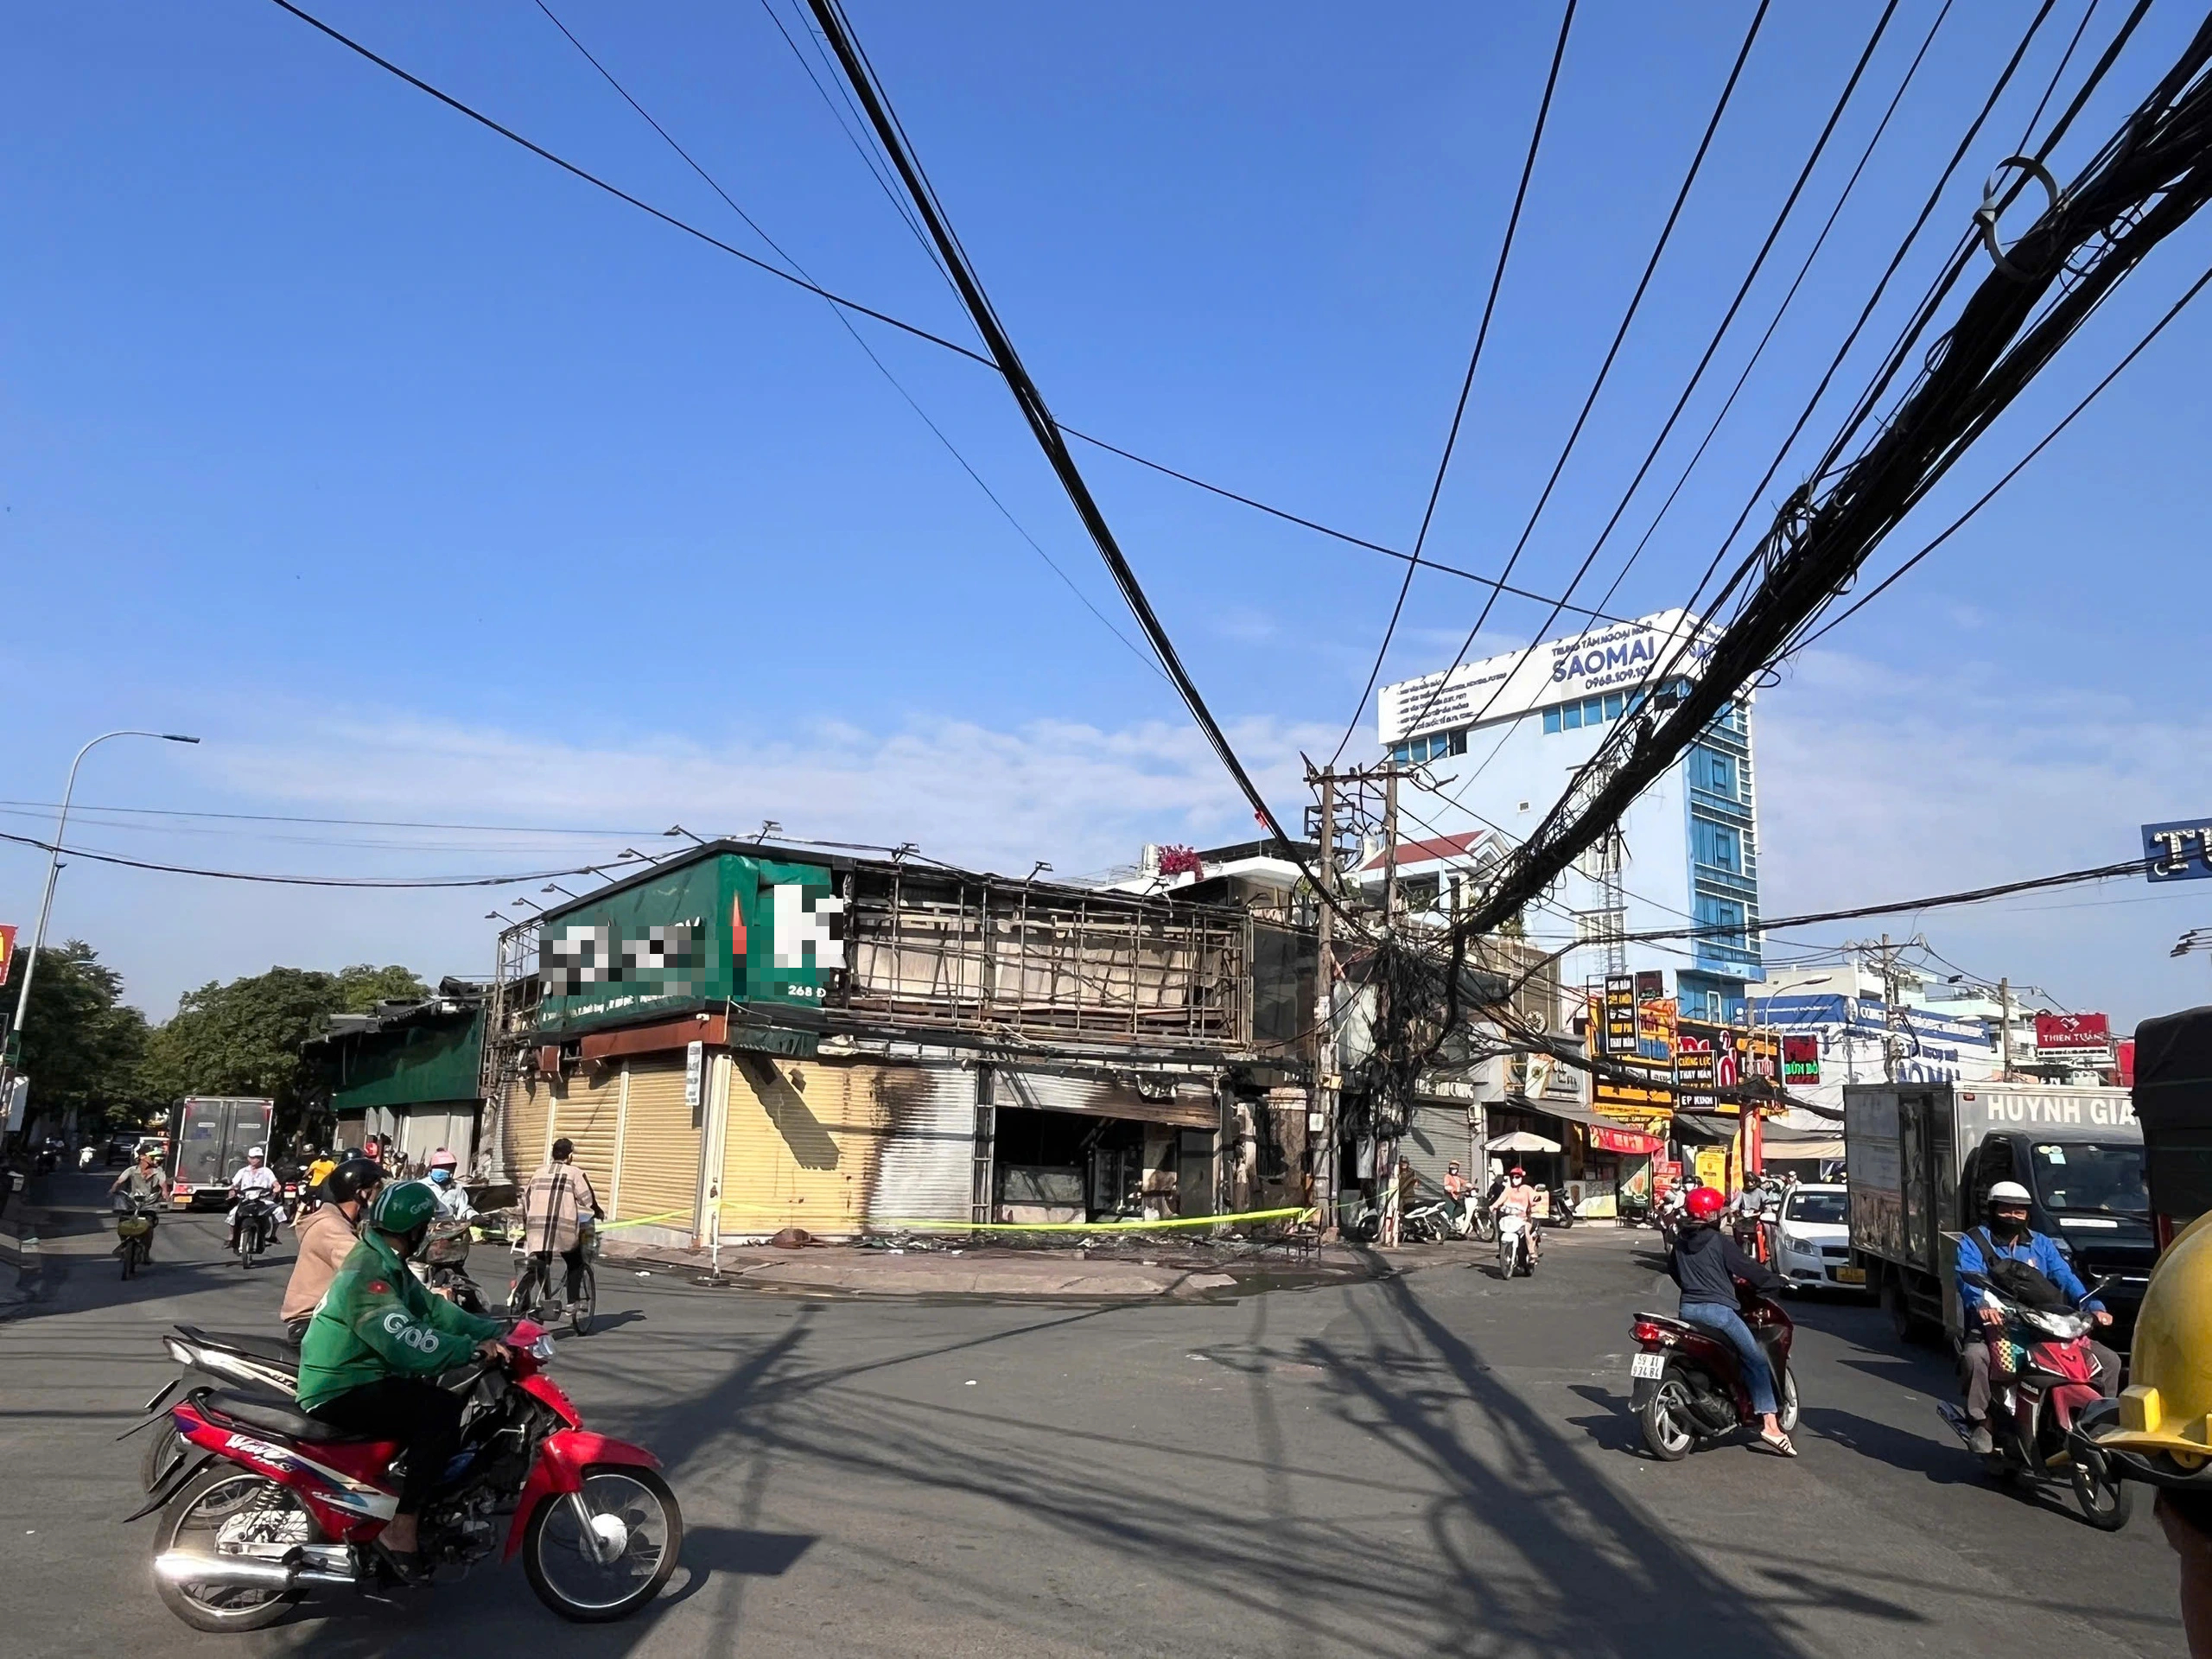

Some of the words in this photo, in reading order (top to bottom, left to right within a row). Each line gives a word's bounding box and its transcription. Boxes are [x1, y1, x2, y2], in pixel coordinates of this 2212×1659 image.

[1552, 636, 1655, 683] SAOMAI
[788, 985, 813, 996] 268
[2090, 1098, 2137, 1125] GIA
[384, 1313, 439, 1353] Grab
[225, 1433, 289, 1459] Wave
